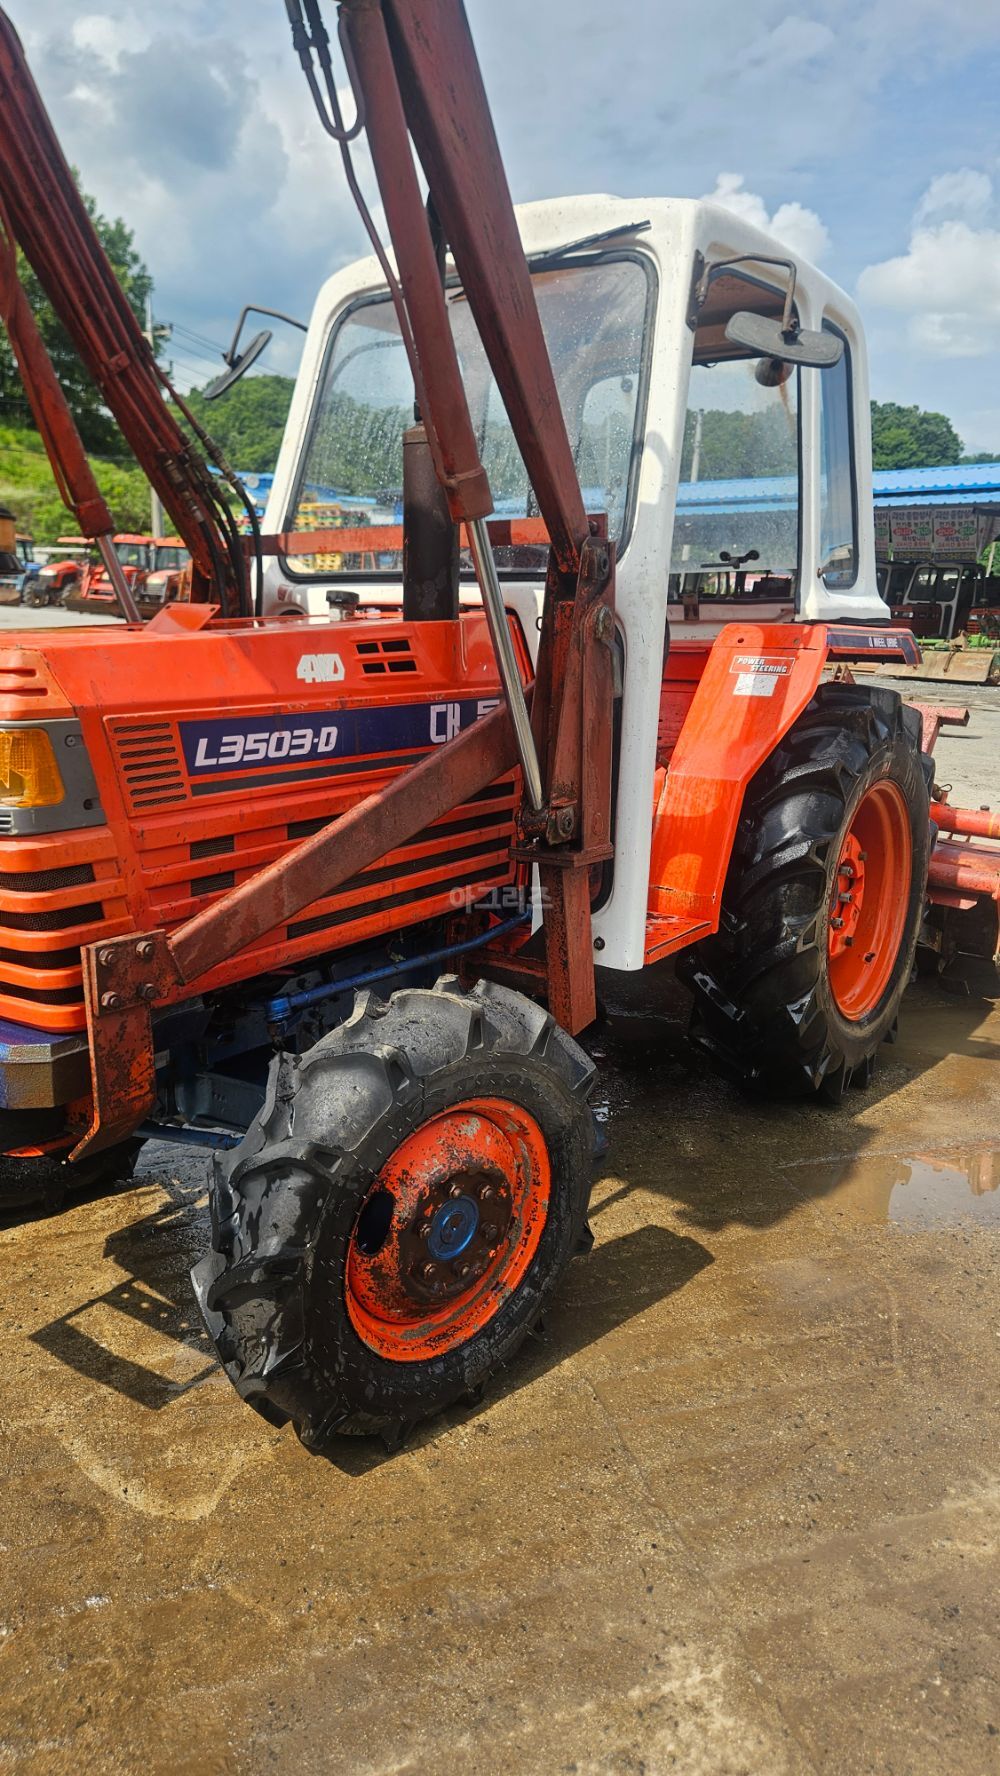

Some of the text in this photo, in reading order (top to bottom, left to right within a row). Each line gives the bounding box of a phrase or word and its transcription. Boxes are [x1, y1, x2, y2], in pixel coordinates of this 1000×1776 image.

[296, 653, 346, 684] 4WD
[737, 656, 766, 665] POWER
[750, 664, 788, 673] STEERING
[194, 725, 338, 767] L3503-D
